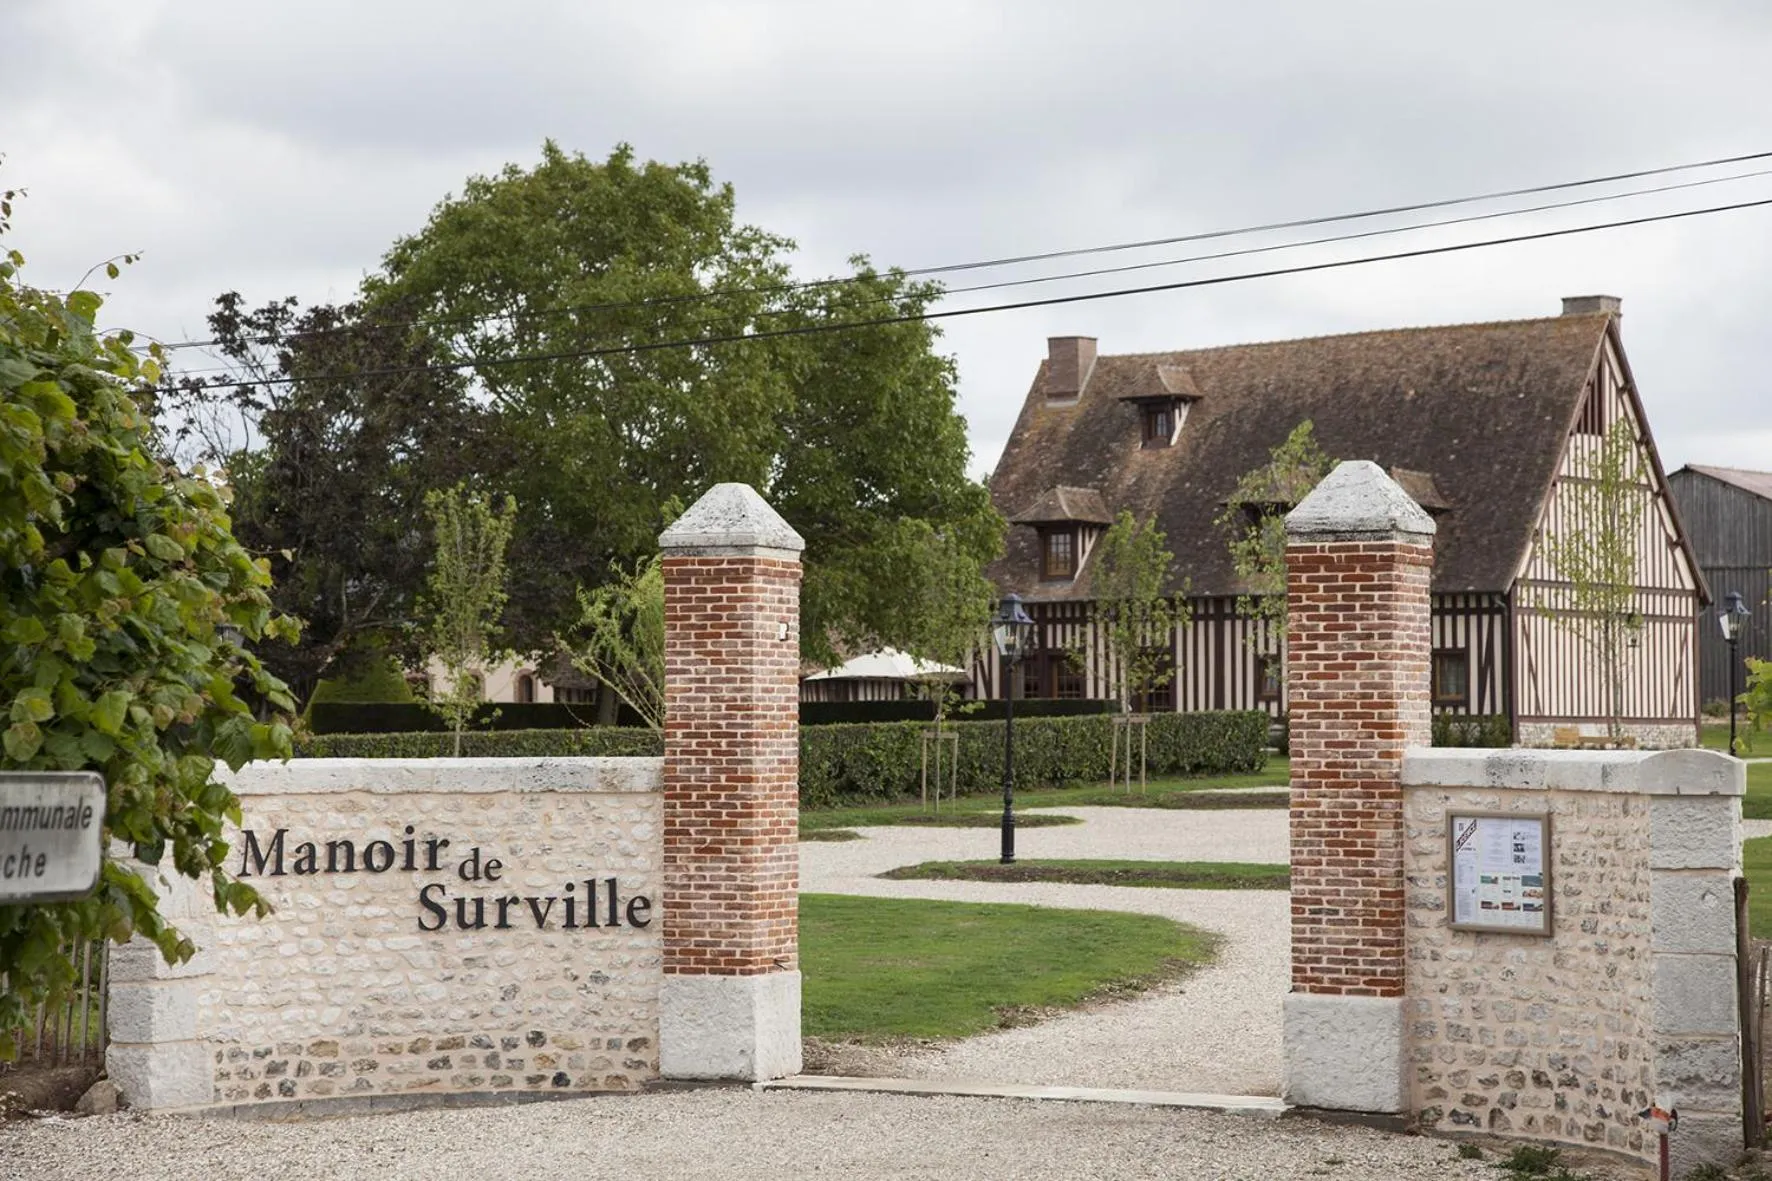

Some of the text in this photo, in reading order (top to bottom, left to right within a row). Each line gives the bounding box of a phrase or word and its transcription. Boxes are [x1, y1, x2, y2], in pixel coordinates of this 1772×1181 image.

[0, 796, 93, 831] mmunale
[0, 843, 47, 879] che
[238, 825, 503, 881] Manoir de
[418, 877, 652, 931] Surville
